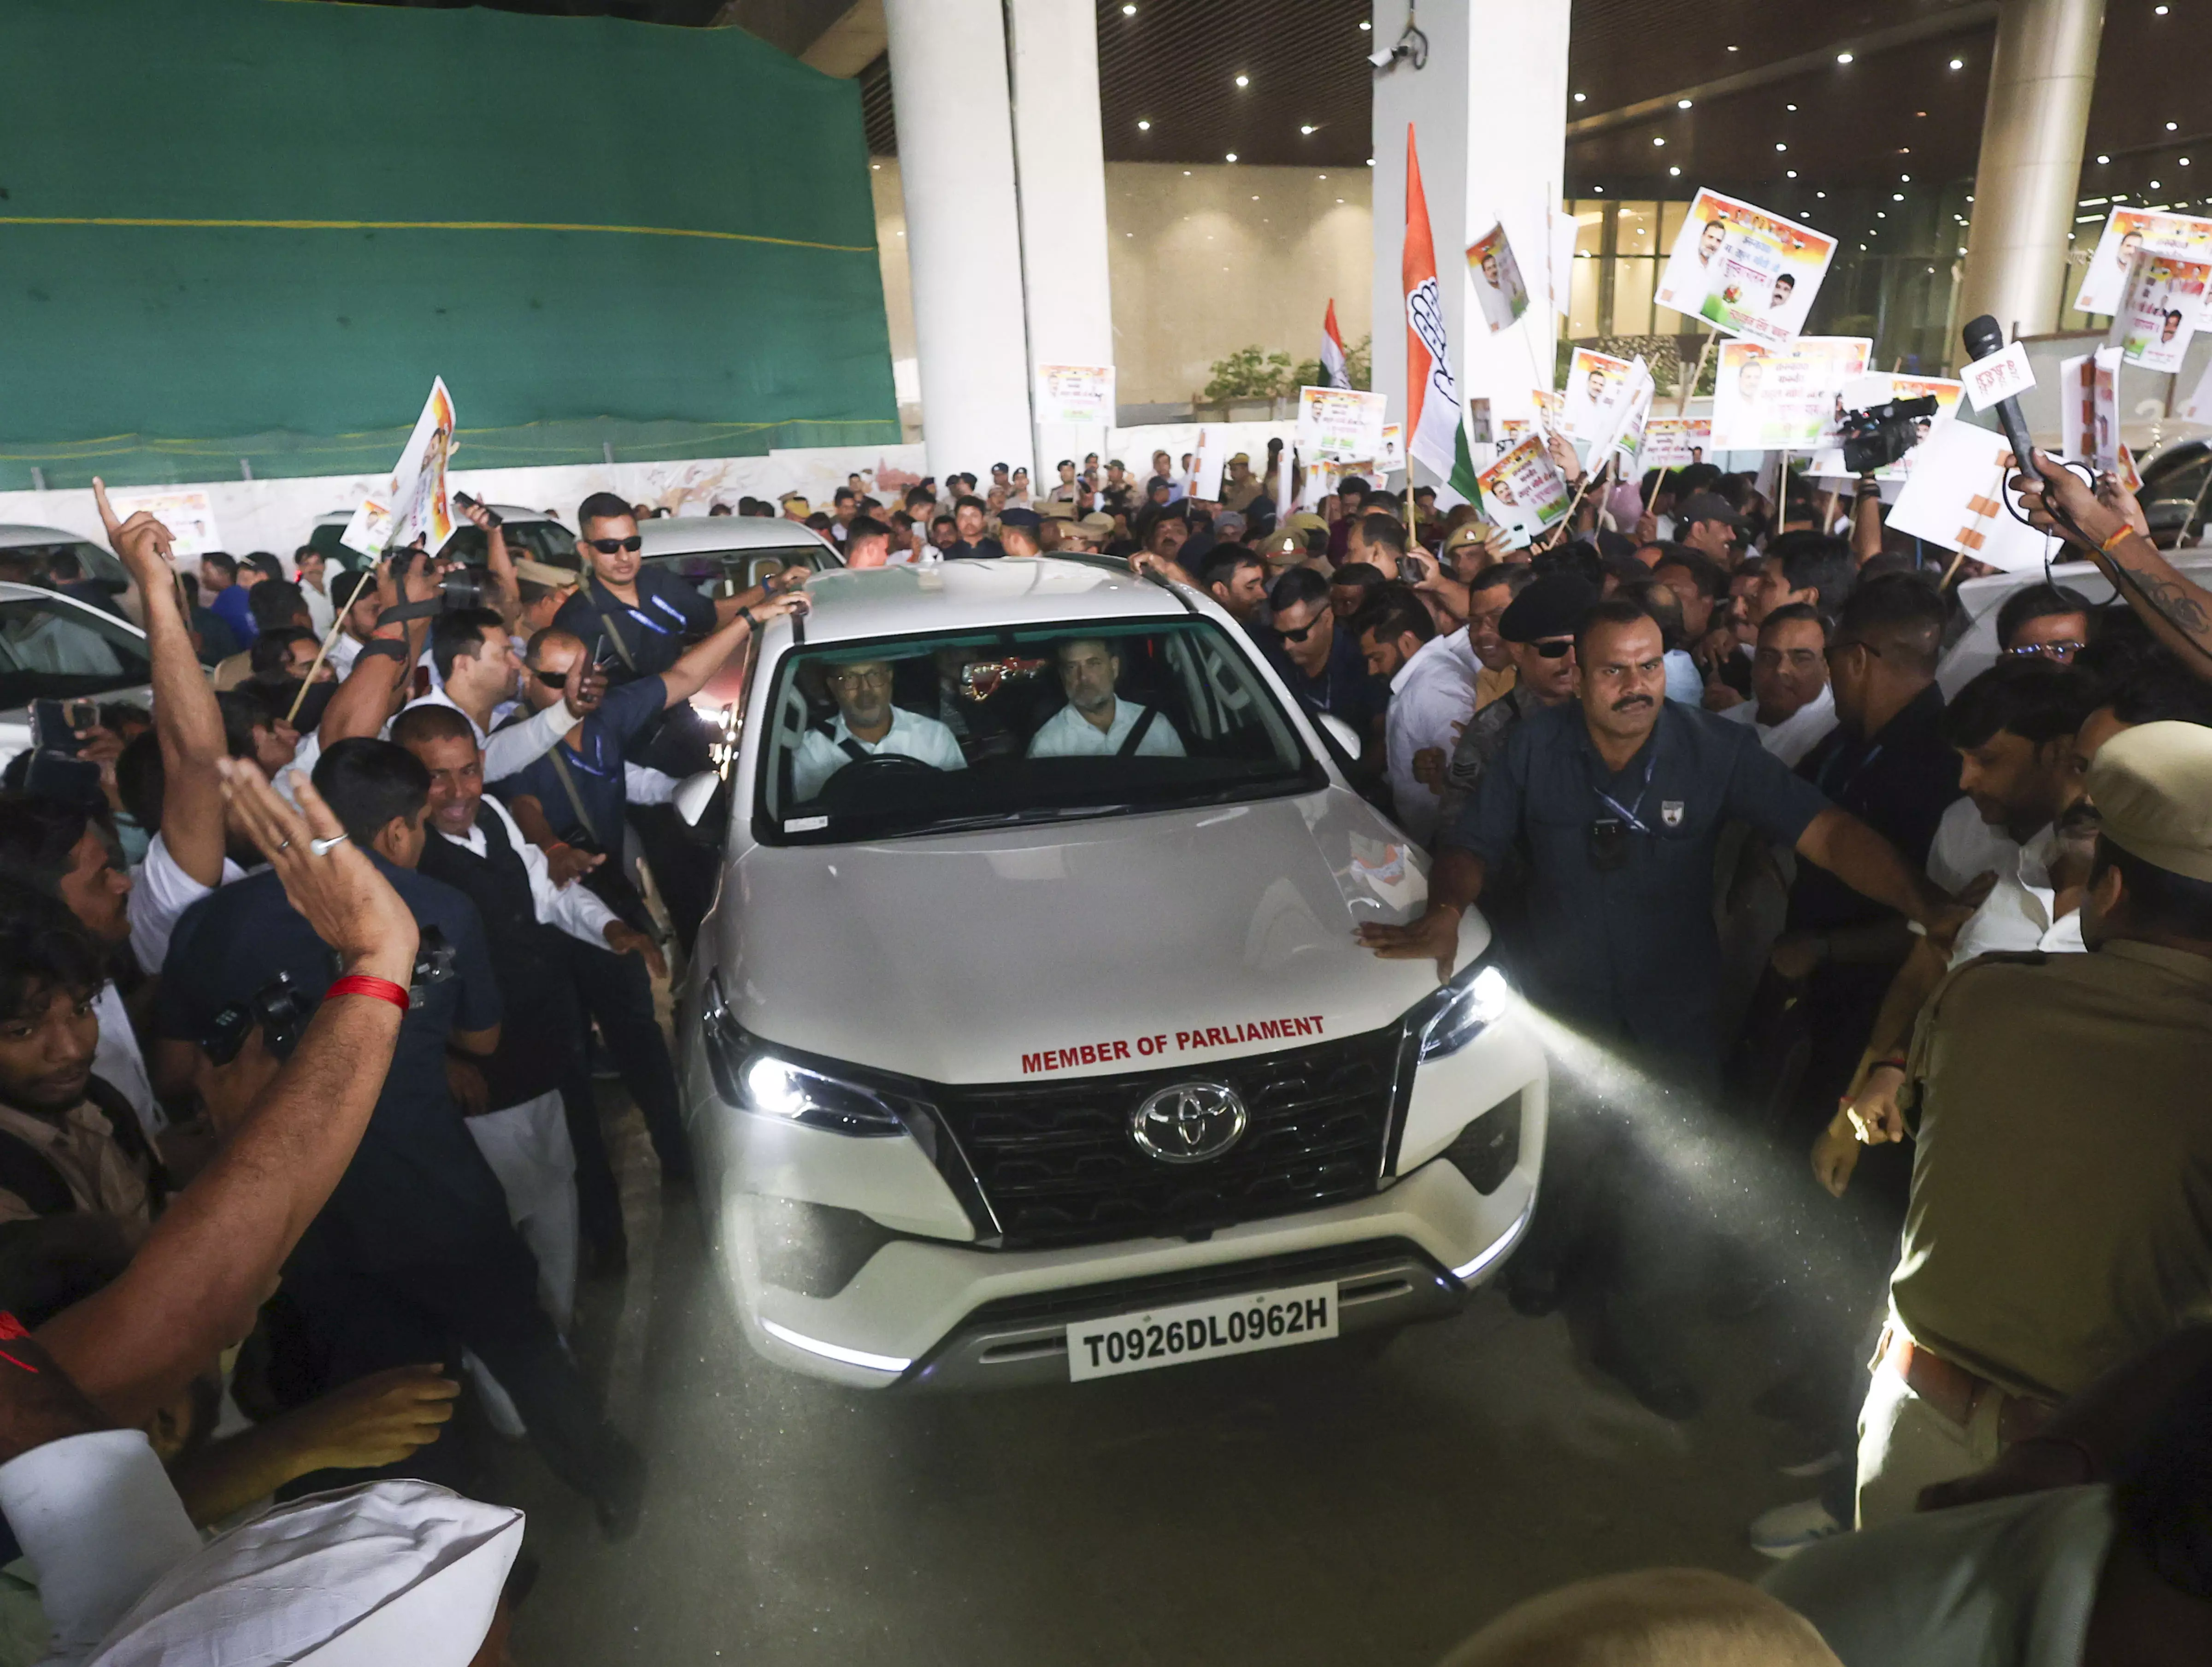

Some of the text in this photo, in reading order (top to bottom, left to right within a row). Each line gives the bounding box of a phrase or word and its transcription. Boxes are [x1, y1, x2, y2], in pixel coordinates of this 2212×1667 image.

[1022, 1015, 1324, 1074] MEMBER OF PARLIAMENT
[1082, 1297, 1327, 1367] T0926DL0962H
